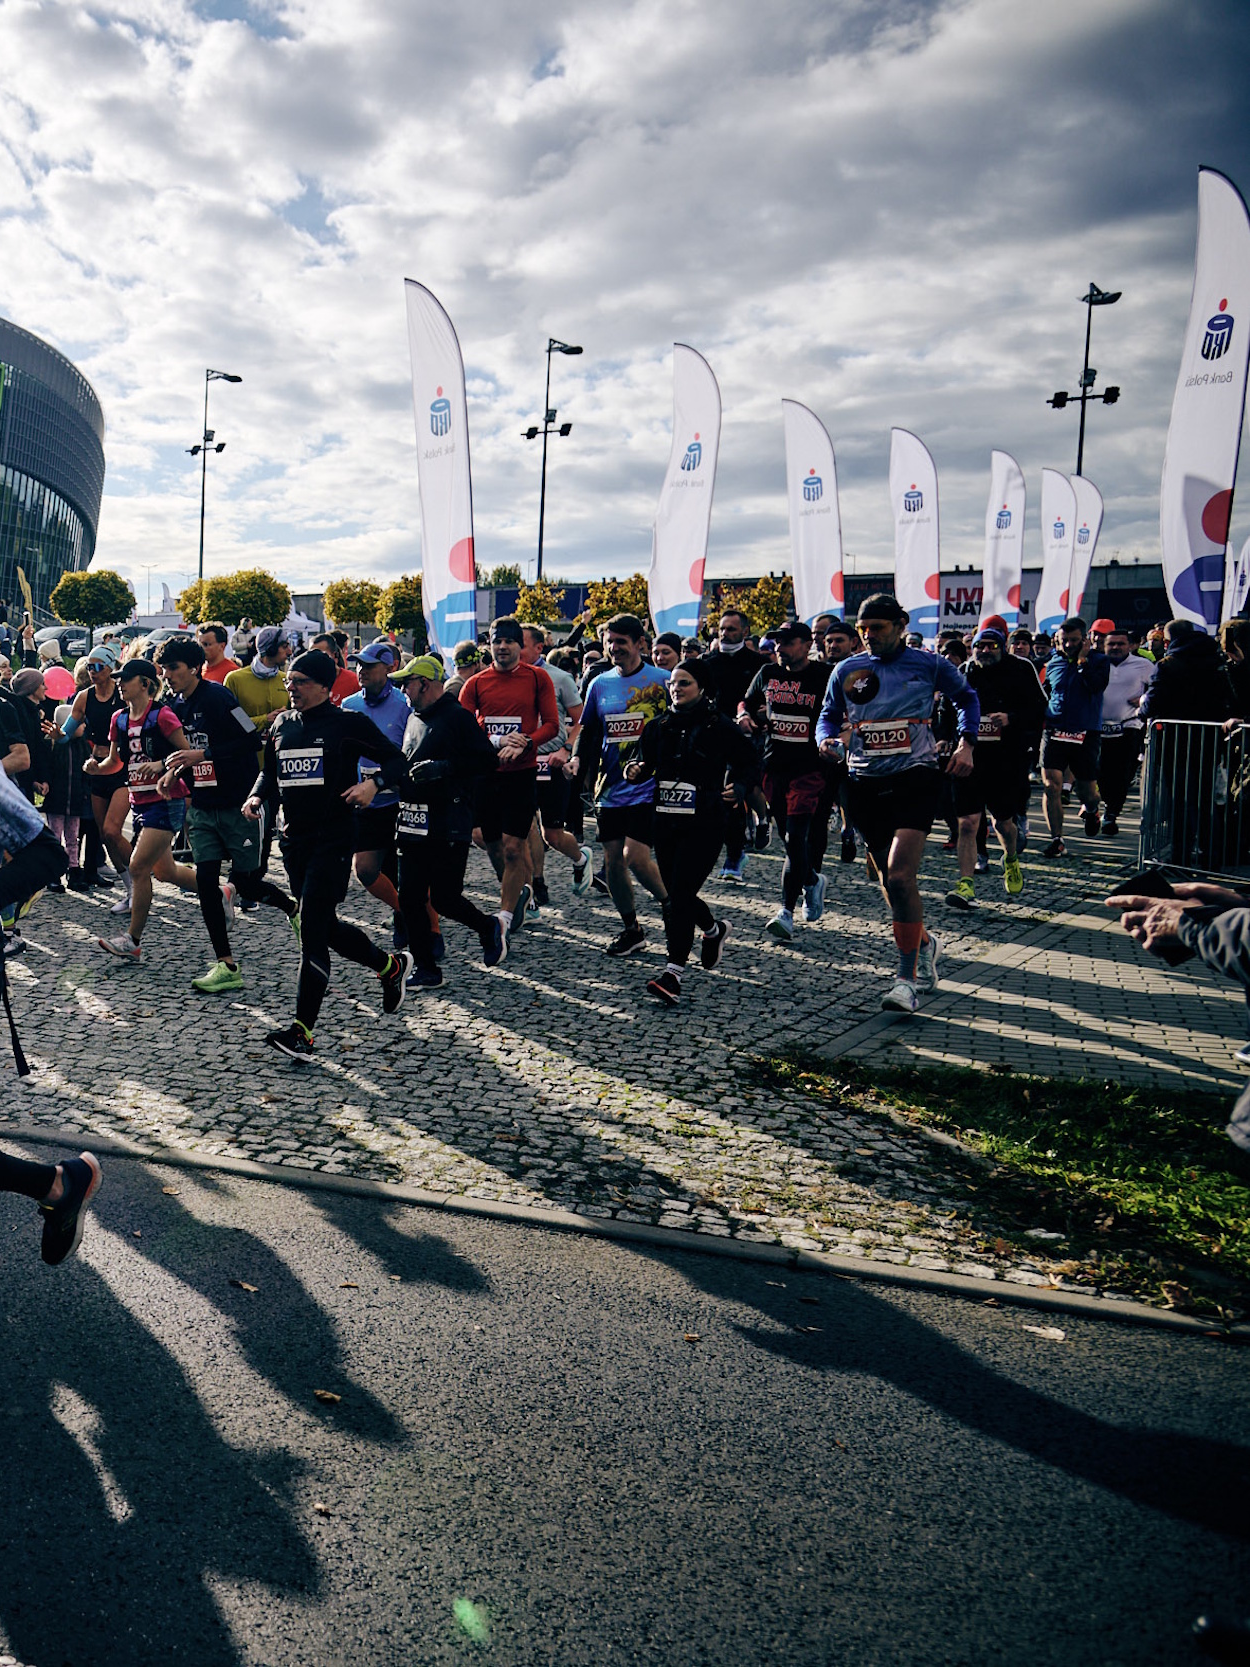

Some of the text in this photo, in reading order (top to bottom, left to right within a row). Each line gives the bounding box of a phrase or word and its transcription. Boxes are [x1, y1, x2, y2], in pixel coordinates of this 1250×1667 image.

[767, 679, 801, 695] IRON
[486, 724, 519, 735] 10472
[608, 720, 642, 733] 20227
[773, 721, 807, 733] 20970
[864, 730, 907, 744] 20120
[281, 758, 320, 773] 10087
[660, 790, 692, 802] 10272
